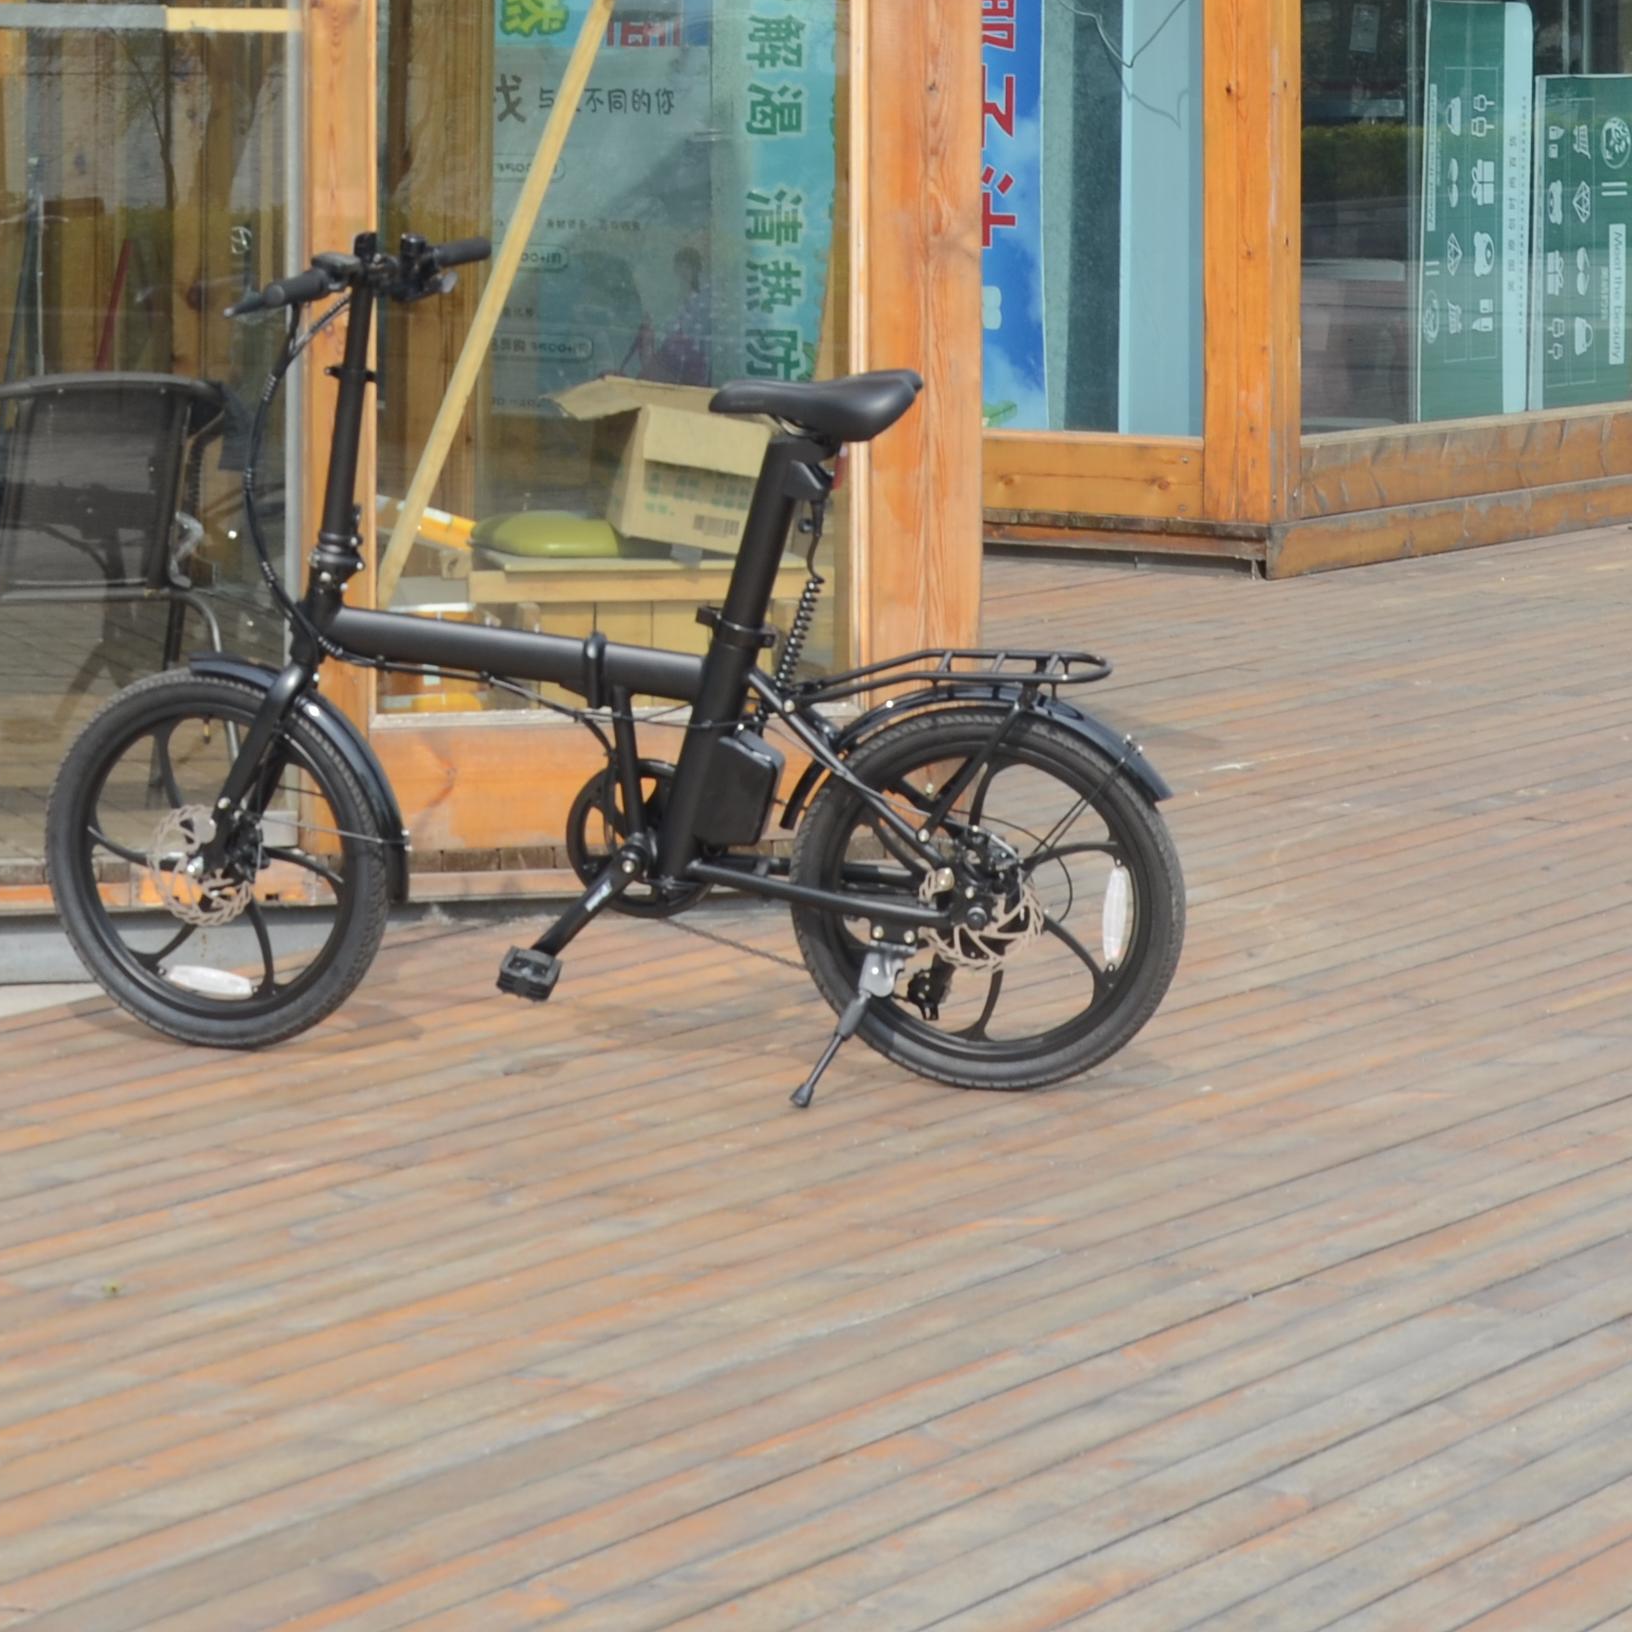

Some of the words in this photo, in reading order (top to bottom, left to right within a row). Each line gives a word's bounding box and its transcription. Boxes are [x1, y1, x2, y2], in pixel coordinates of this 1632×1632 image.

[538, 86, 675, 116] 与不同的你
[1613, 231, 1624, 271] Meet
[1612, 305, 1624, 359] beauty
